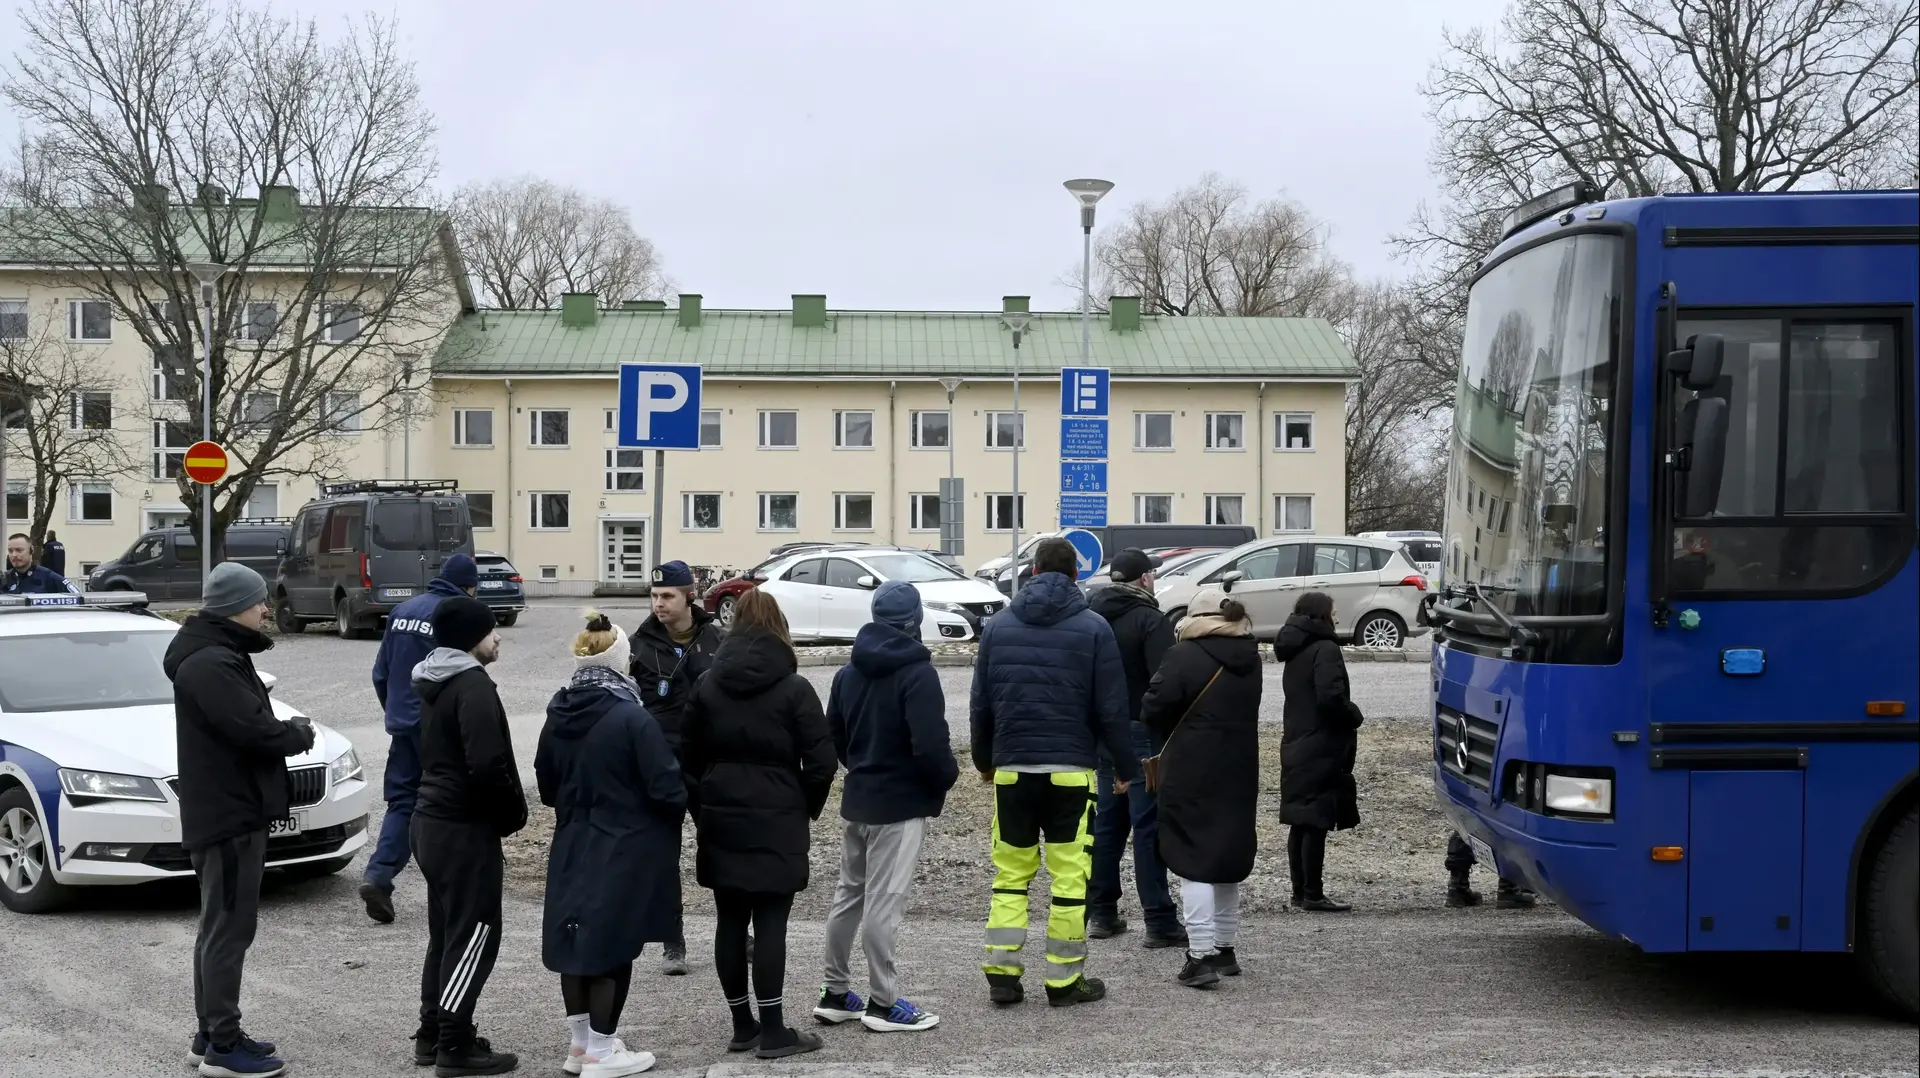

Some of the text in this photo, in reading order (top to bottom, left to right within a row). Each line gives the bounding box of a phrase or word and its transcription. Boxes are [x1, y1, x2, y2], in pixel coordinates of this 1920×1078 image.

[637, 371, 689, 440] P
[1083, 473, 1096, 481] 2 h
[269, 816, 296, 833] 890
